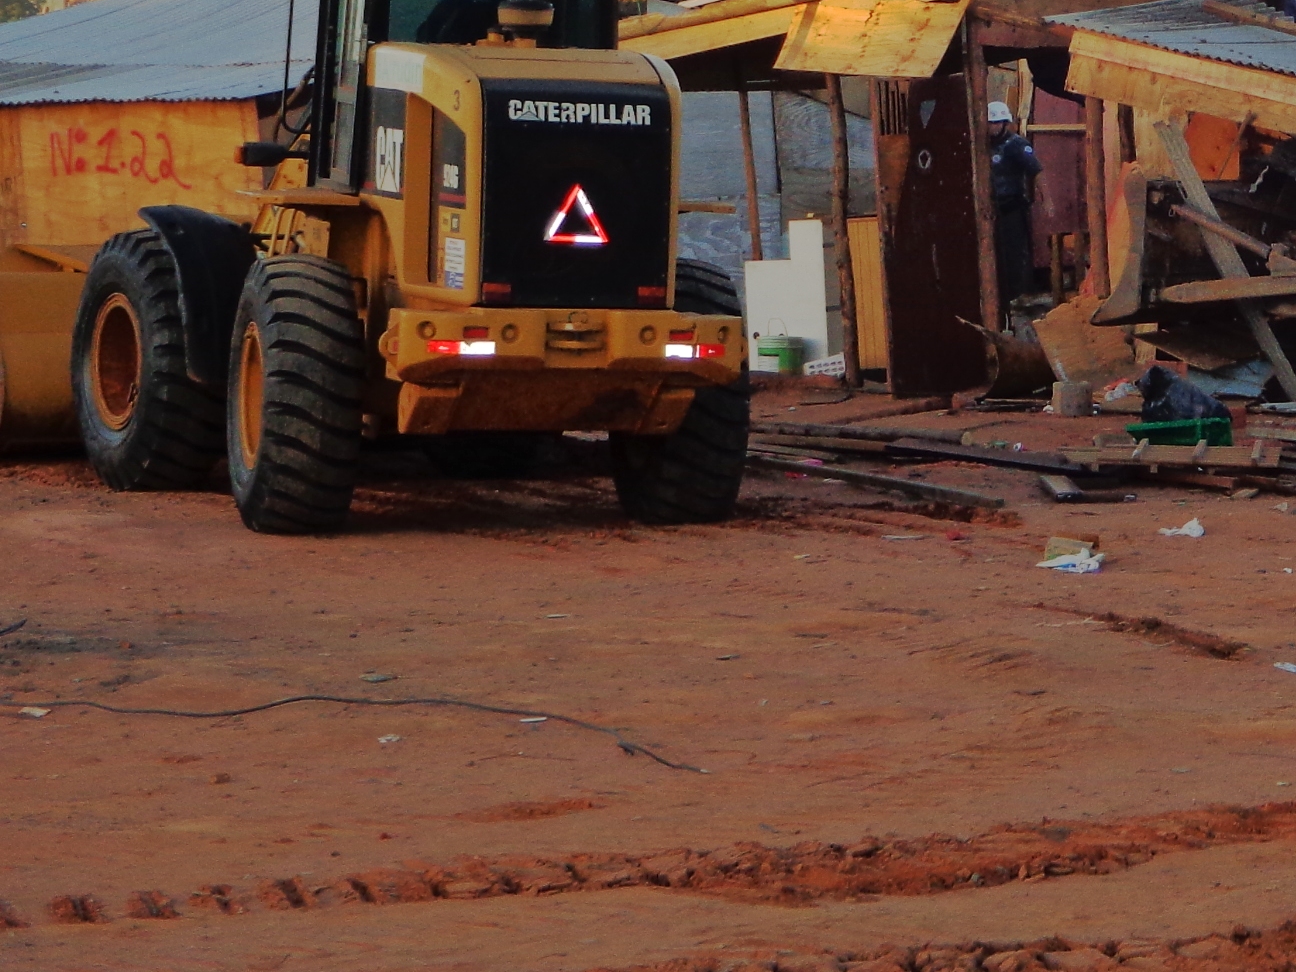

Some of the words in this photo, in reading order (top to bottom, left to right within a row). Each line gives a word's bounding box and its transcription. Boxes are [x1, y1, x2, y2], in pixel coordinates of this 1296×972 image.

[453, 89, 461, 112] 3
[508, 99, 651, 126] CATERPILLAR
[376, 125, 404, 193] CAT
